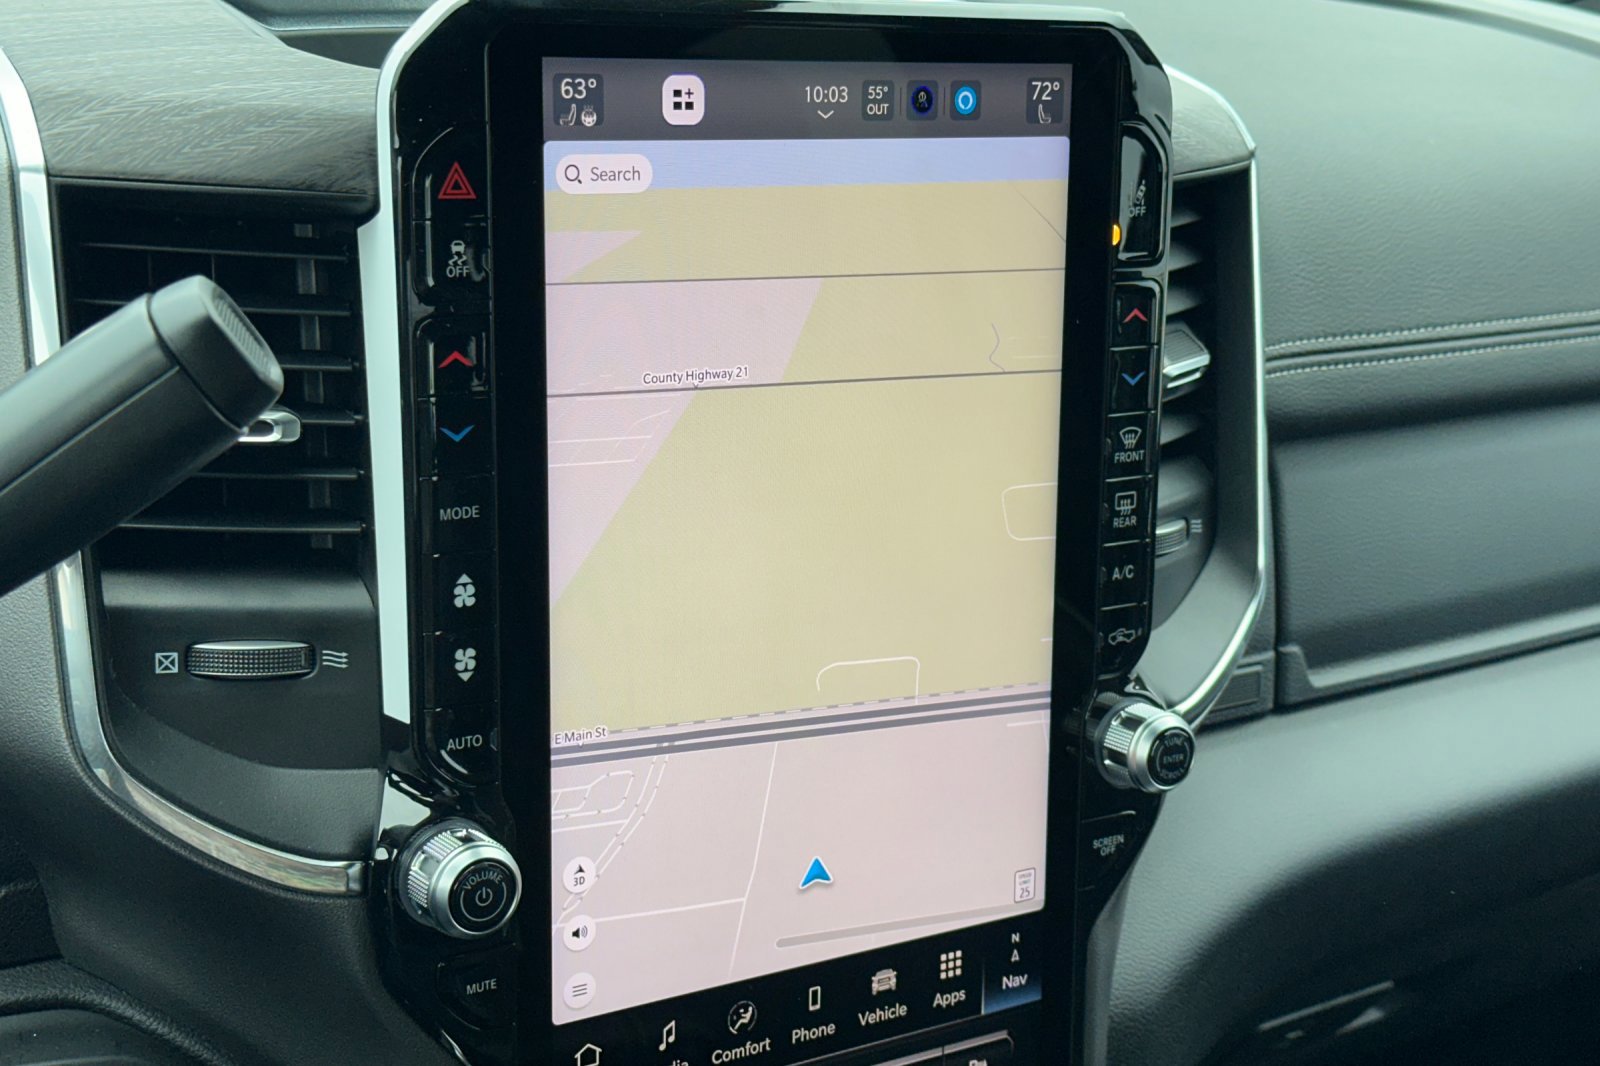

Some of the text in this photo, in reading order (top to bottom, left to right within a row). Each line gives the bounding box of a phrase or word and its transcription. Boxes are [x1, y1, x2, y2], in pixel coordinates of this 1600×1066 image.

[560, 78, 597, 99] 63°
[804, 86, 849, 103] 10:03
[867, 86, 889, 100] 55°
[1031, 81, 1060, 101] 72°
[866, 103, 889, 115] OUT
[590, 166, 641, 182] Search
[1128, 206, 1147, 218] OFF
[446, 266, 470, 278] OFF
[643, 366, 749, 385] County Highway 21
[1114, 450, 1145, 464] FRONT
[440, 505, 480, 521] MODE
[1113, 516, 1137, 528] REAR
[1112, 565, 1135, 581] A/C
[446, 734, 483, 751] AUTO
[555, 726, 608, 745] E Main St
[1093, 835, 1124, 849] SCREEN
[1100, 845, 1117, 857] OFF
[463, 870, 504, 891] VOLUME
[573, 876, 586, 887] 3D
[1019, 886, 1031, 899] 25
[466, 978, 498, 996] MUTE
[1001, 973, 1029, 991] Nav
[932, 989, 967, 1010] Apps
[858, 1003, 908, 1028] Vehicle
[791, 1022, 836, 1045] Phone
[711, 1038, 771, 1064] Comfort
